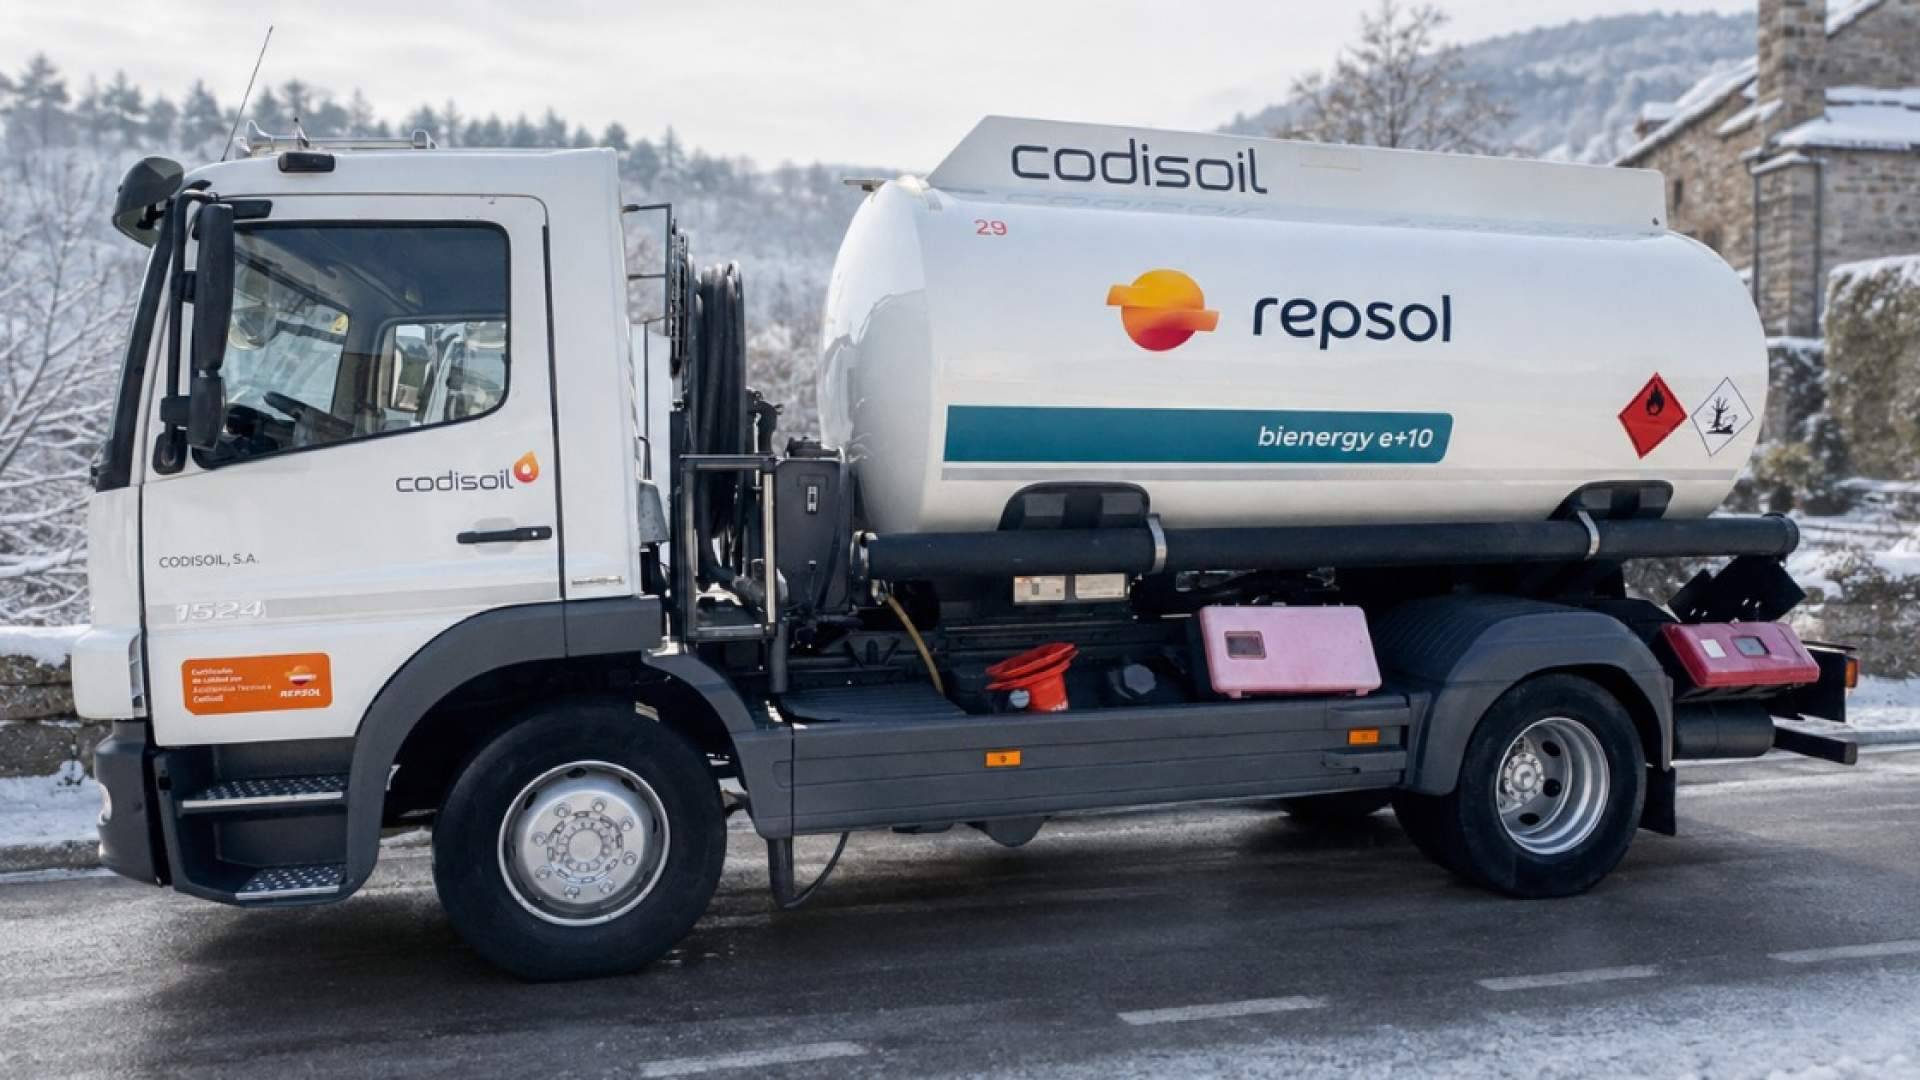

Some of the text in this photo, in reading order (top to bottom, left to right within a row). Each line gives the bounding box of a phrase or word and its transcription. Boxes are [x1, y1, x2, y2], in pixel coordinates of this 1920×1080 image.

[1011, 138, 1268, 195] codisoil
[974, 218, 1008, 236] 29
[1252, 295, 1452, 350] repsol
[1258, 424, 1434, 452] bienergy e+10
[395, 468, 514, 493] codisoil
[159, 552, 261, 568] CODISOIL, S.A.
[176, 599, 266, 624] 1524
[280, 688, 321, 698] REPSOL
